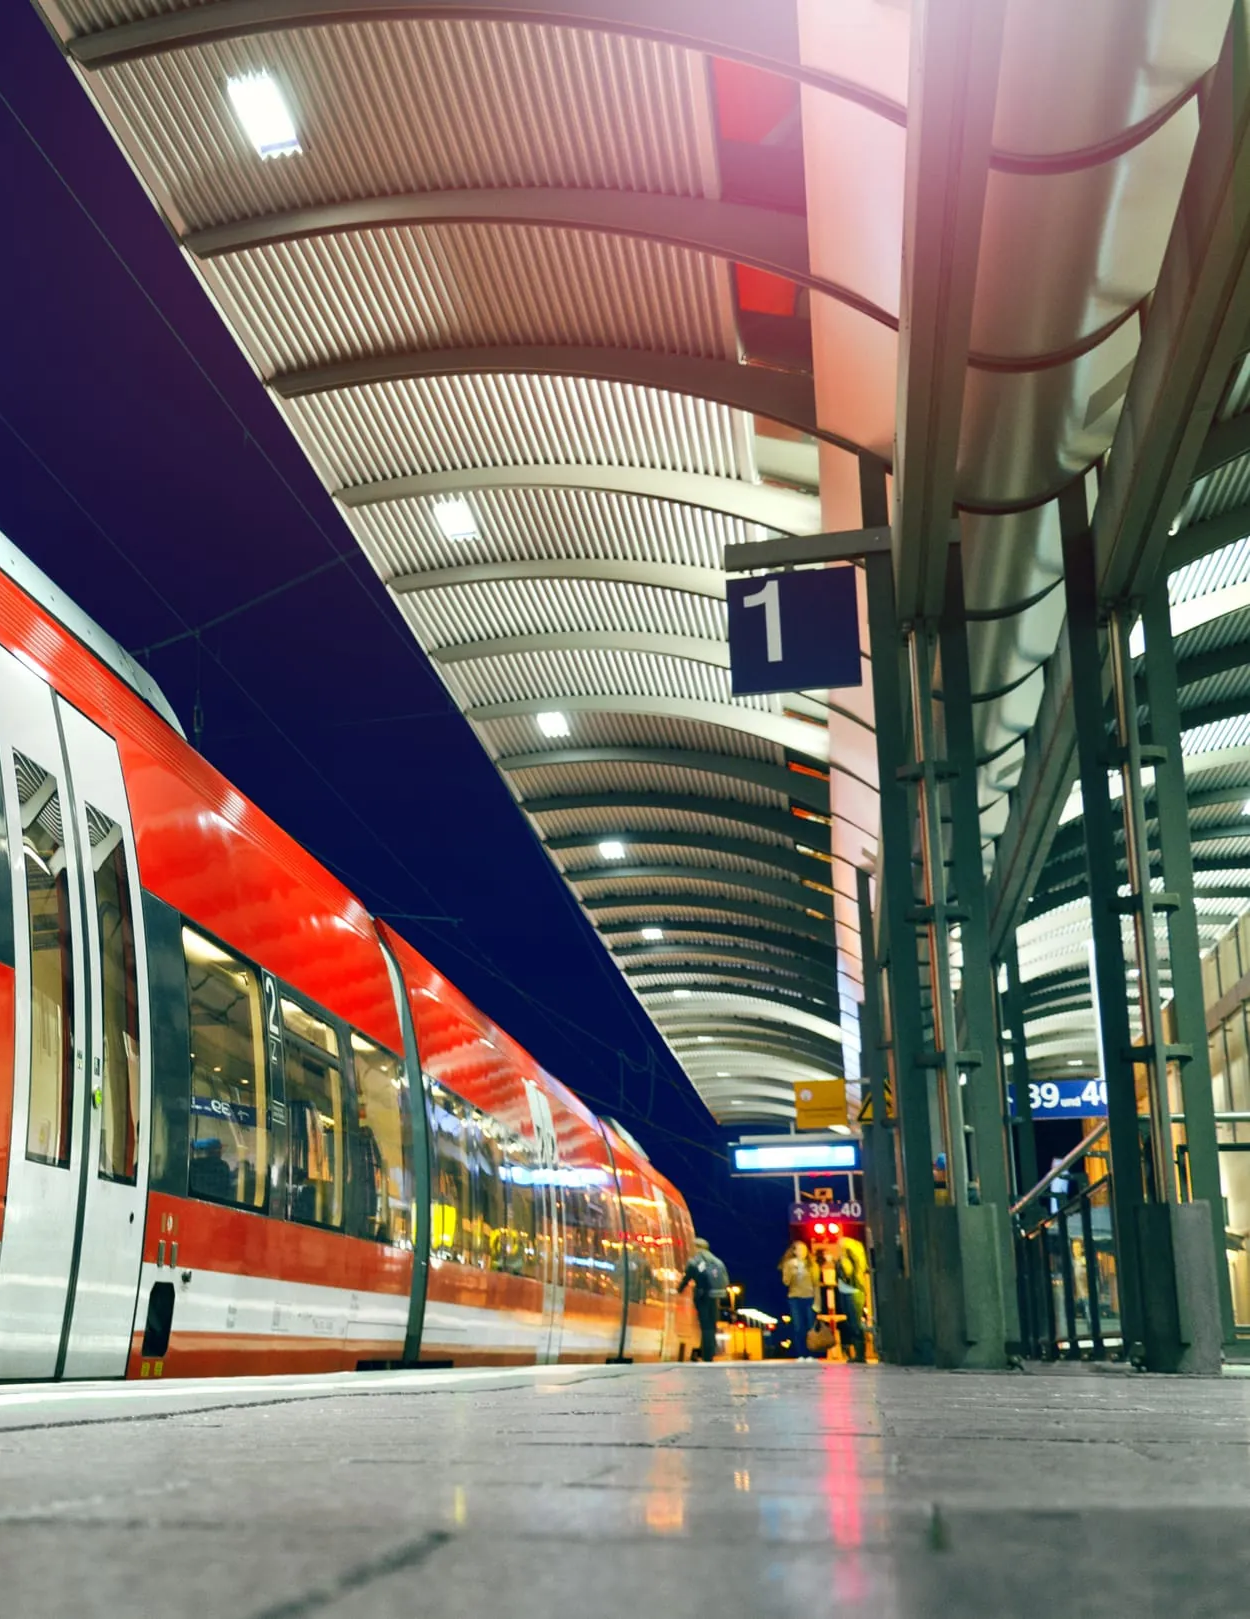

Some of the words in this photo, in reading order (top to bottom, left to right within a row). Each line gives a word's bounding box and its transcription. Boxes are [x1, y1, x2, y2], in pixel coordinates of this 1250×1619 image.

[743, 580, 783, 663] 1
[265, 976, 279, 1035] 2
[1028, 1082, 1060, 1109] 39
[809, 1203, 830, 1218] 39
[841, 1202, 862, 1218] 40
